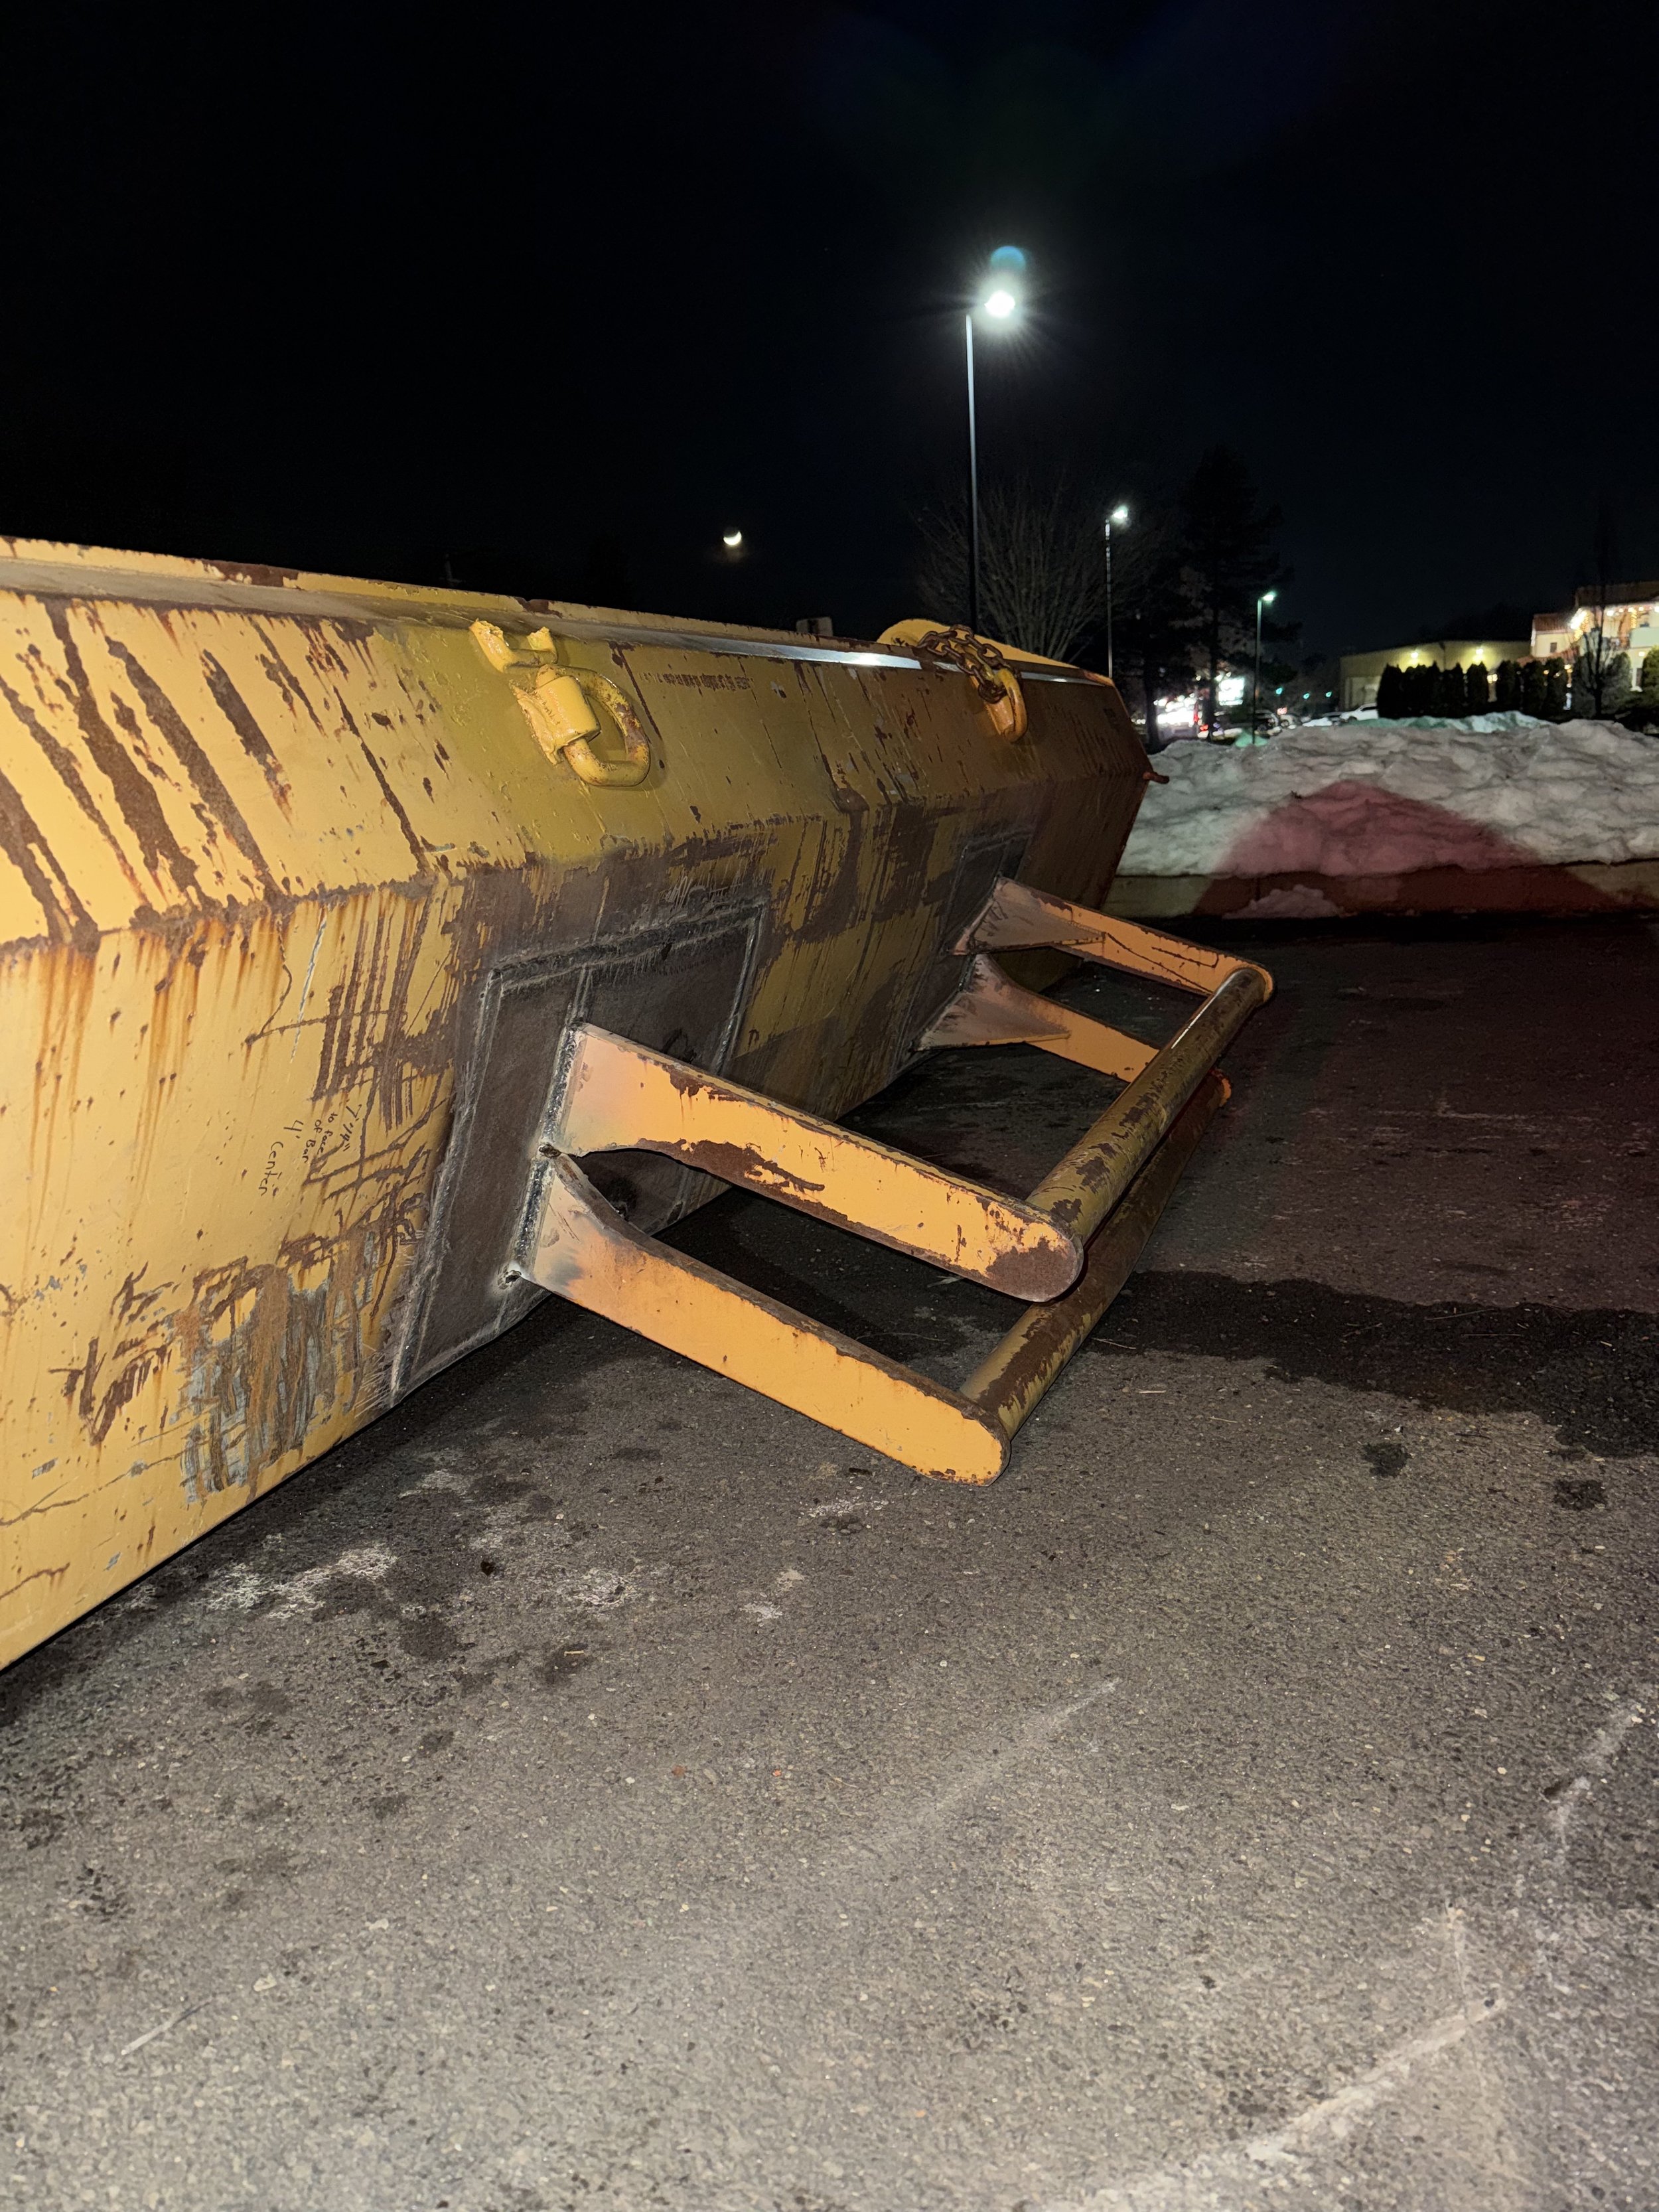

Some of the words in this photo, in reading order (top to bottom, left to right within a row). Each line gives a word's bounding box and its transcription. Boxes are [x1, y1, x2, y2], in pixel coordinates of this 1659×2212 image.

[328, 1112, 338, 1123] to
[302, 1139, 316, 1163] Bar
[317, 1130, 333, 1155] face
[258, 1142, 283, 1196] Center
